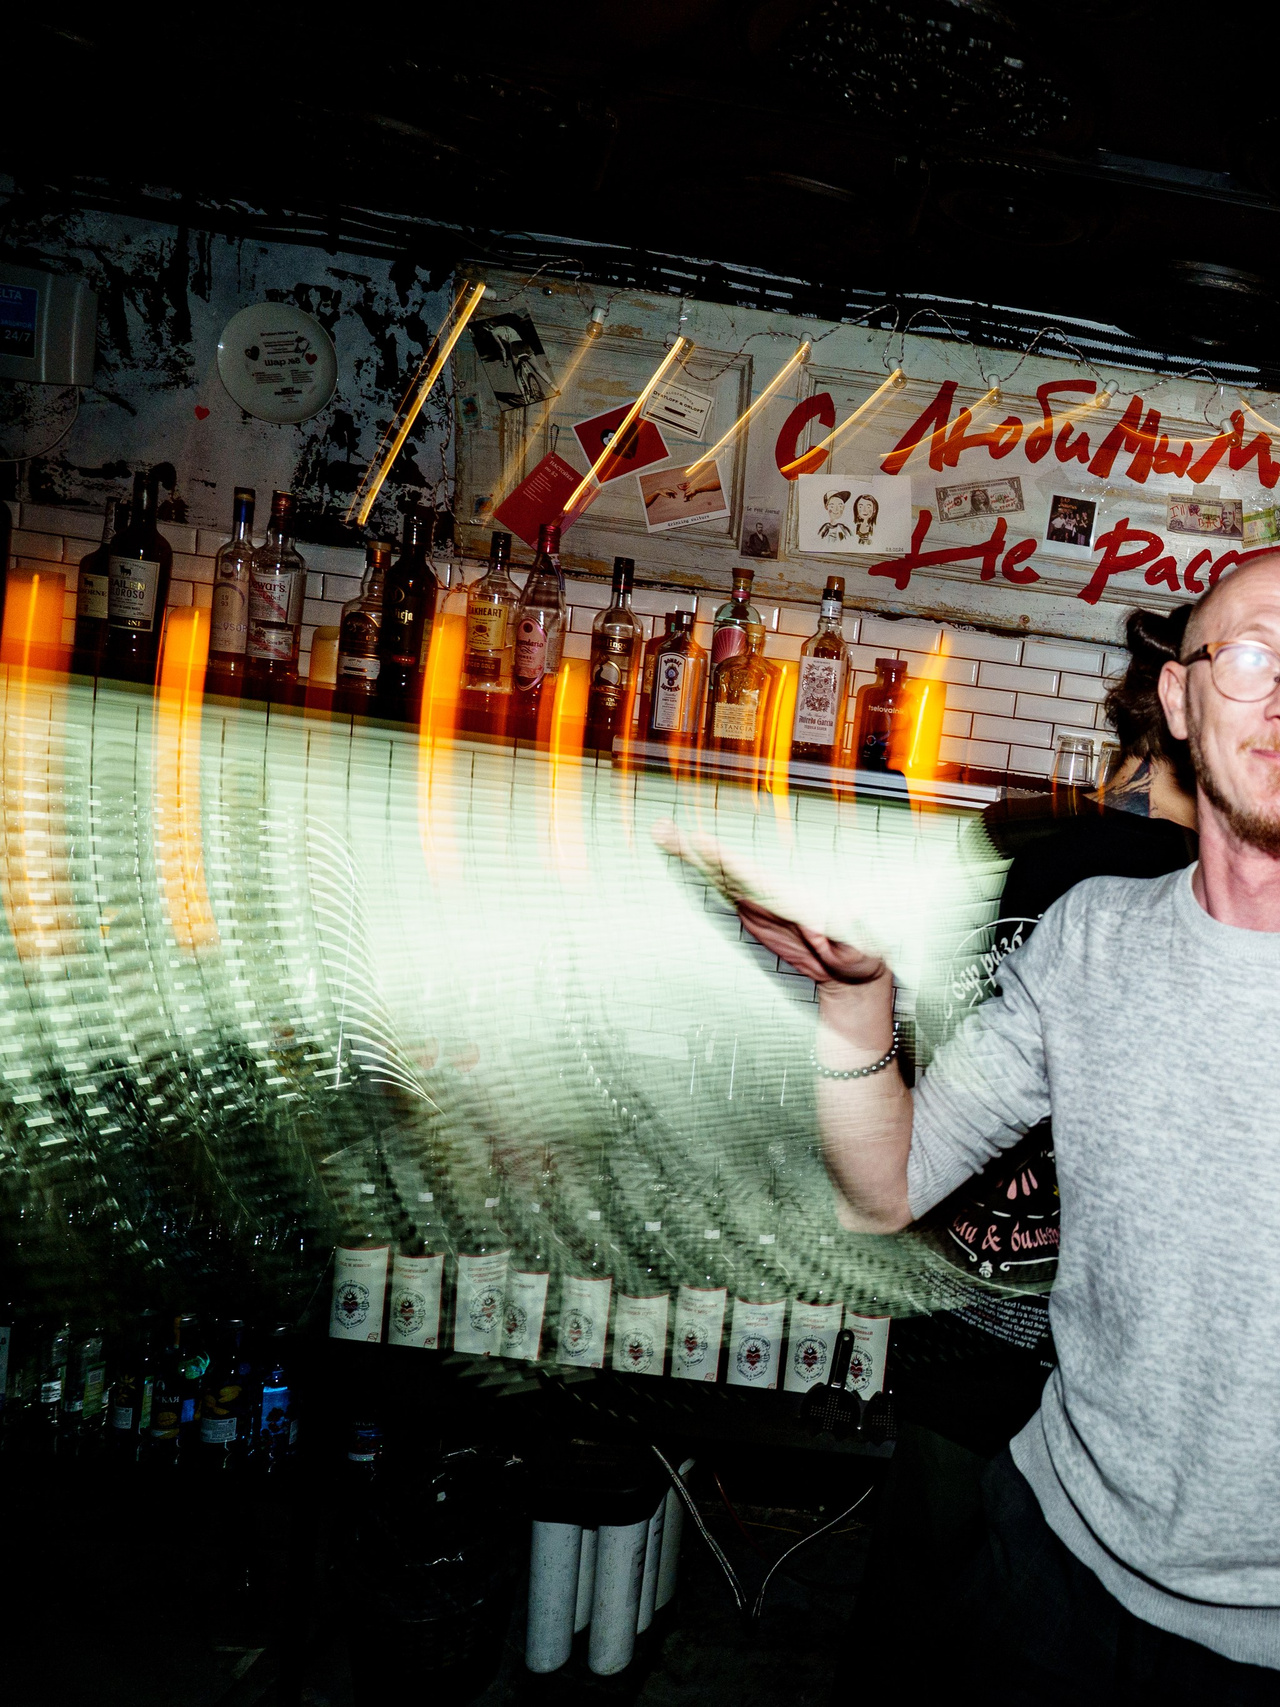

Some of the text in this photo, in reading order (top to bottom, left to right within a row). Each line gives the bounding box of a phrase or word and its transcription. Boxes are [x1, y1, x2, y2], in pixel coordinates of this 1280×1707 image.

[0, 289, 23, 300] LTA
[4, 329, 31, 342] 24/7
[774, 392, 837, 481] С
[868, 509, 1041, 590] Не
[663, 658, 682, 667] BOMBAY
[660, 682, 681, 692] SAPPHIRE
[716, 722, 753, 732] ESTANCIA
[981, 1224, 1003, 1252] &
